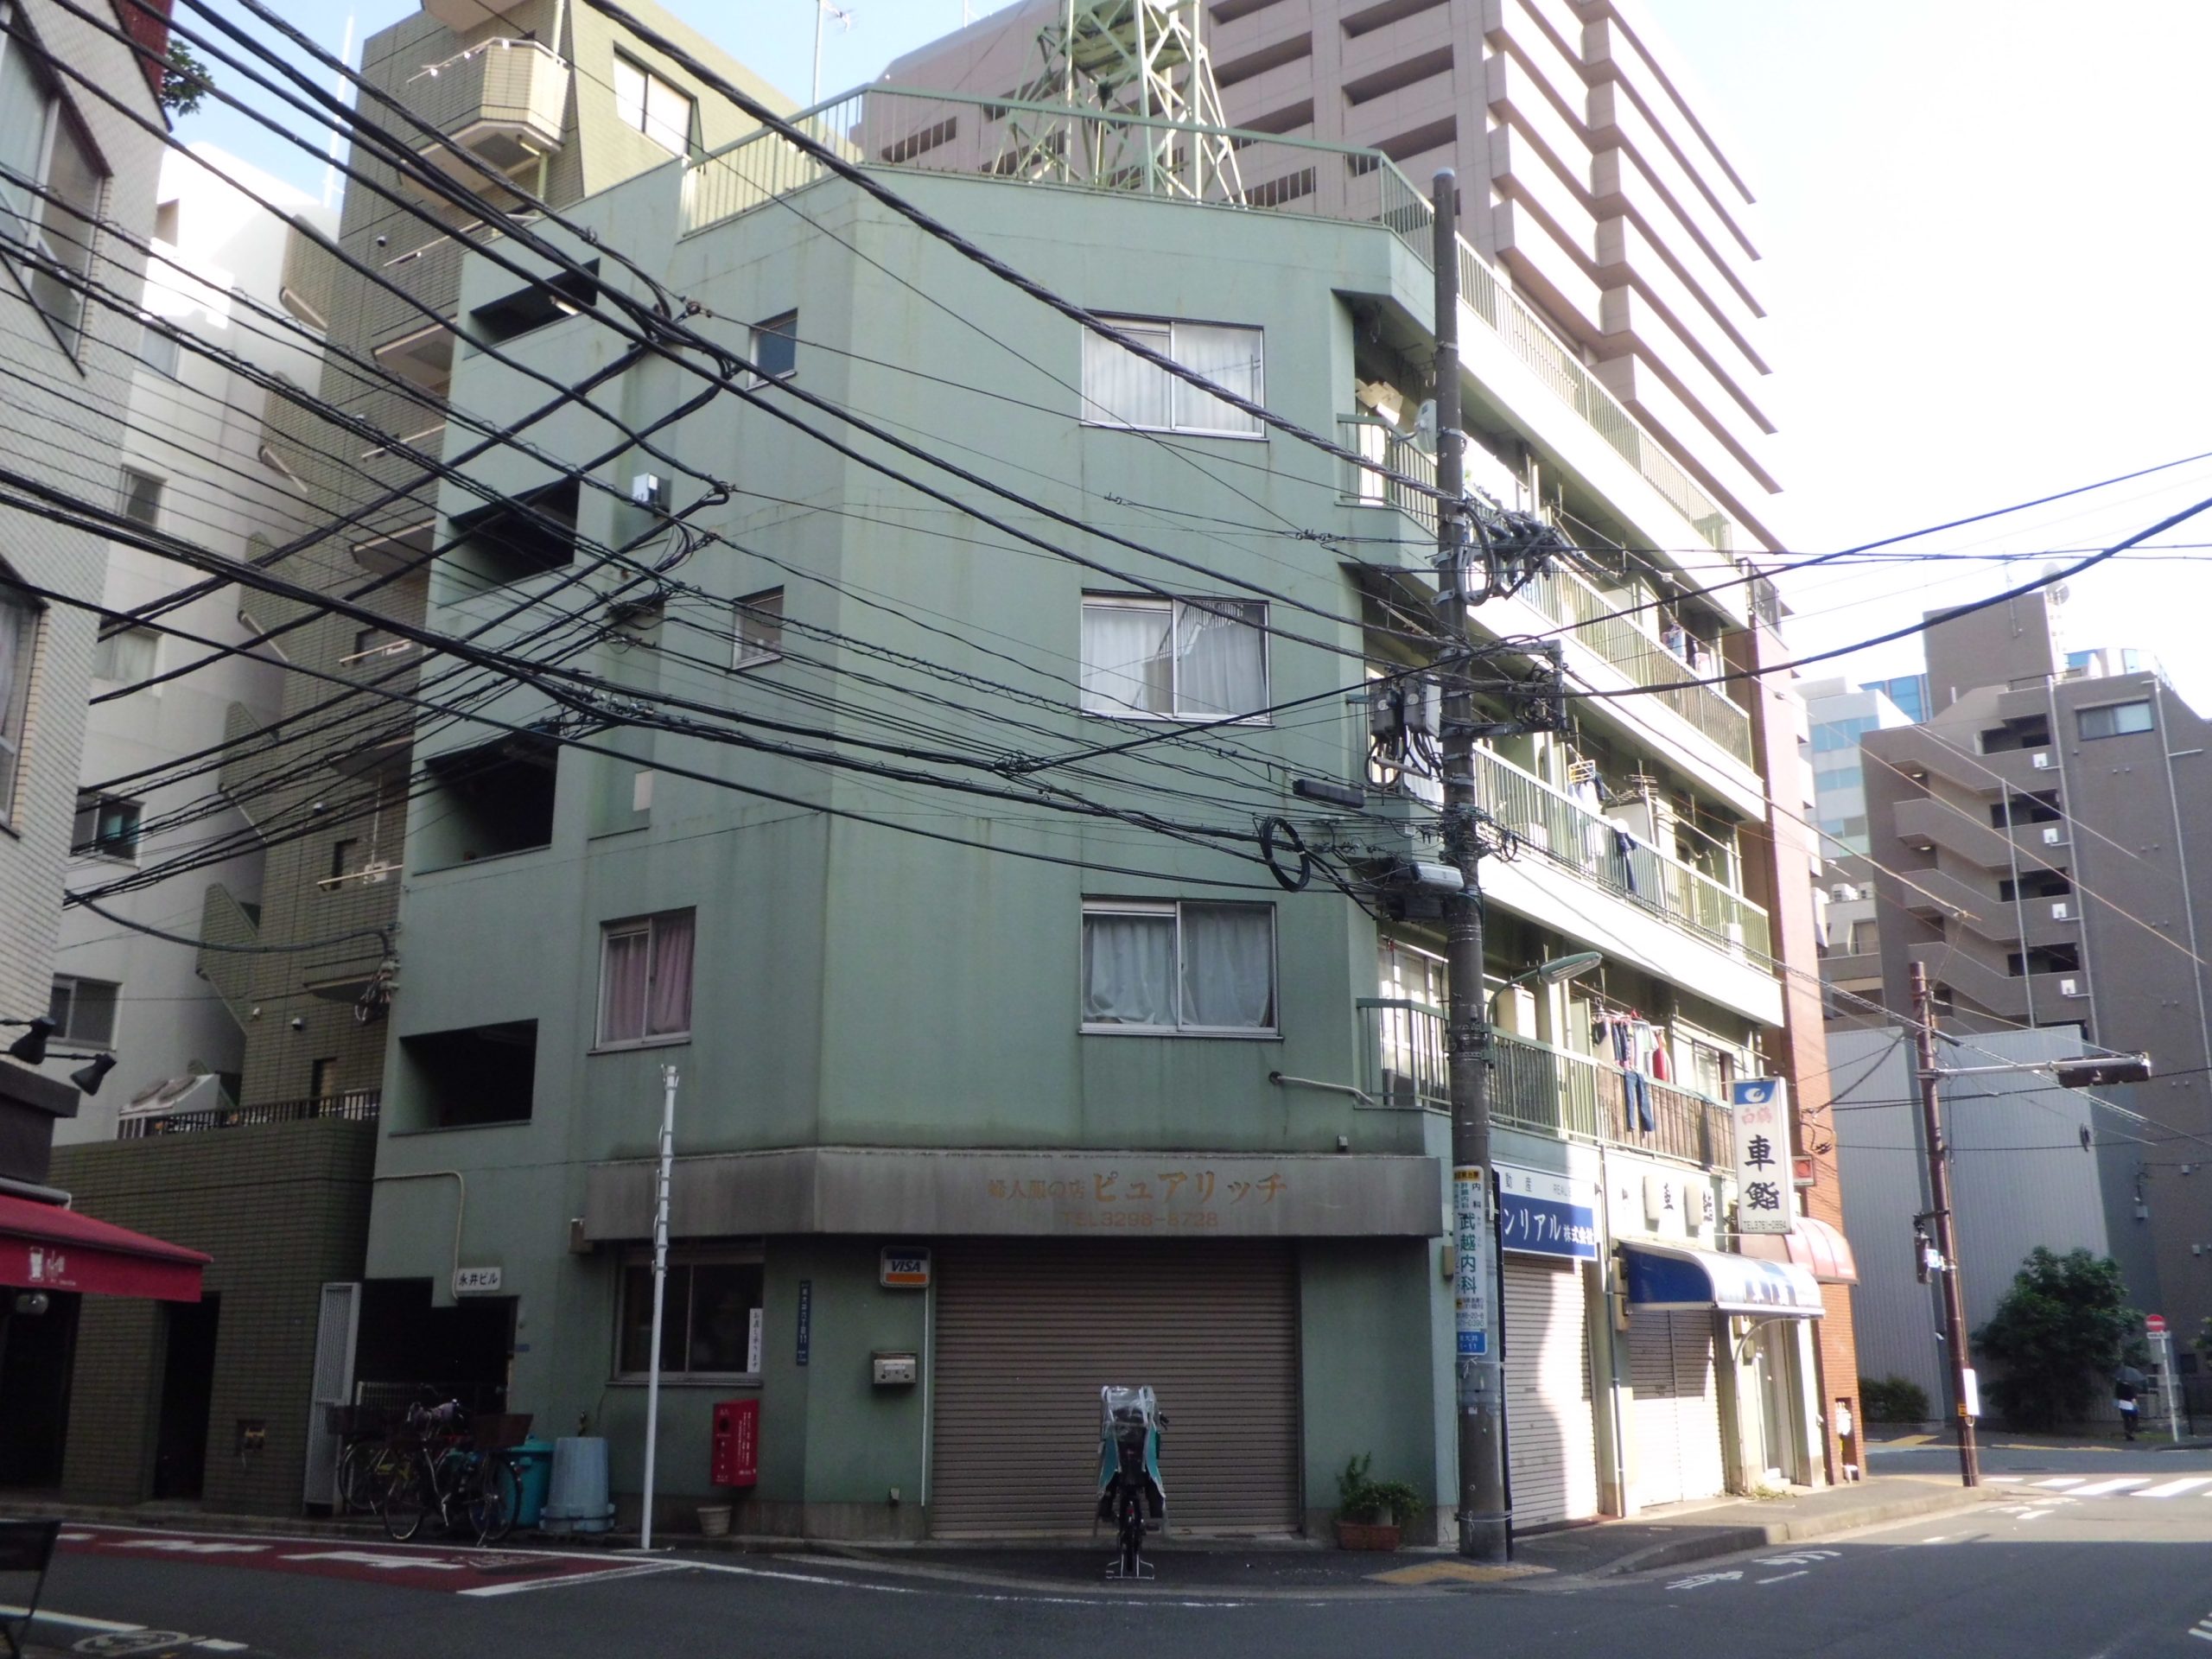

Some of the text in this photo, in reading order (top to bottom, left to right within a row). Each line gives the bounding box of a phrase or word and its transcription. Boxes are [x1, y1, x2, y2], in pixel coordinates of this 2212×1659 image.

[1093, 1170, 1287, 1205] ピュアリッチ
[892, 1261, 921, 1272] VISA
